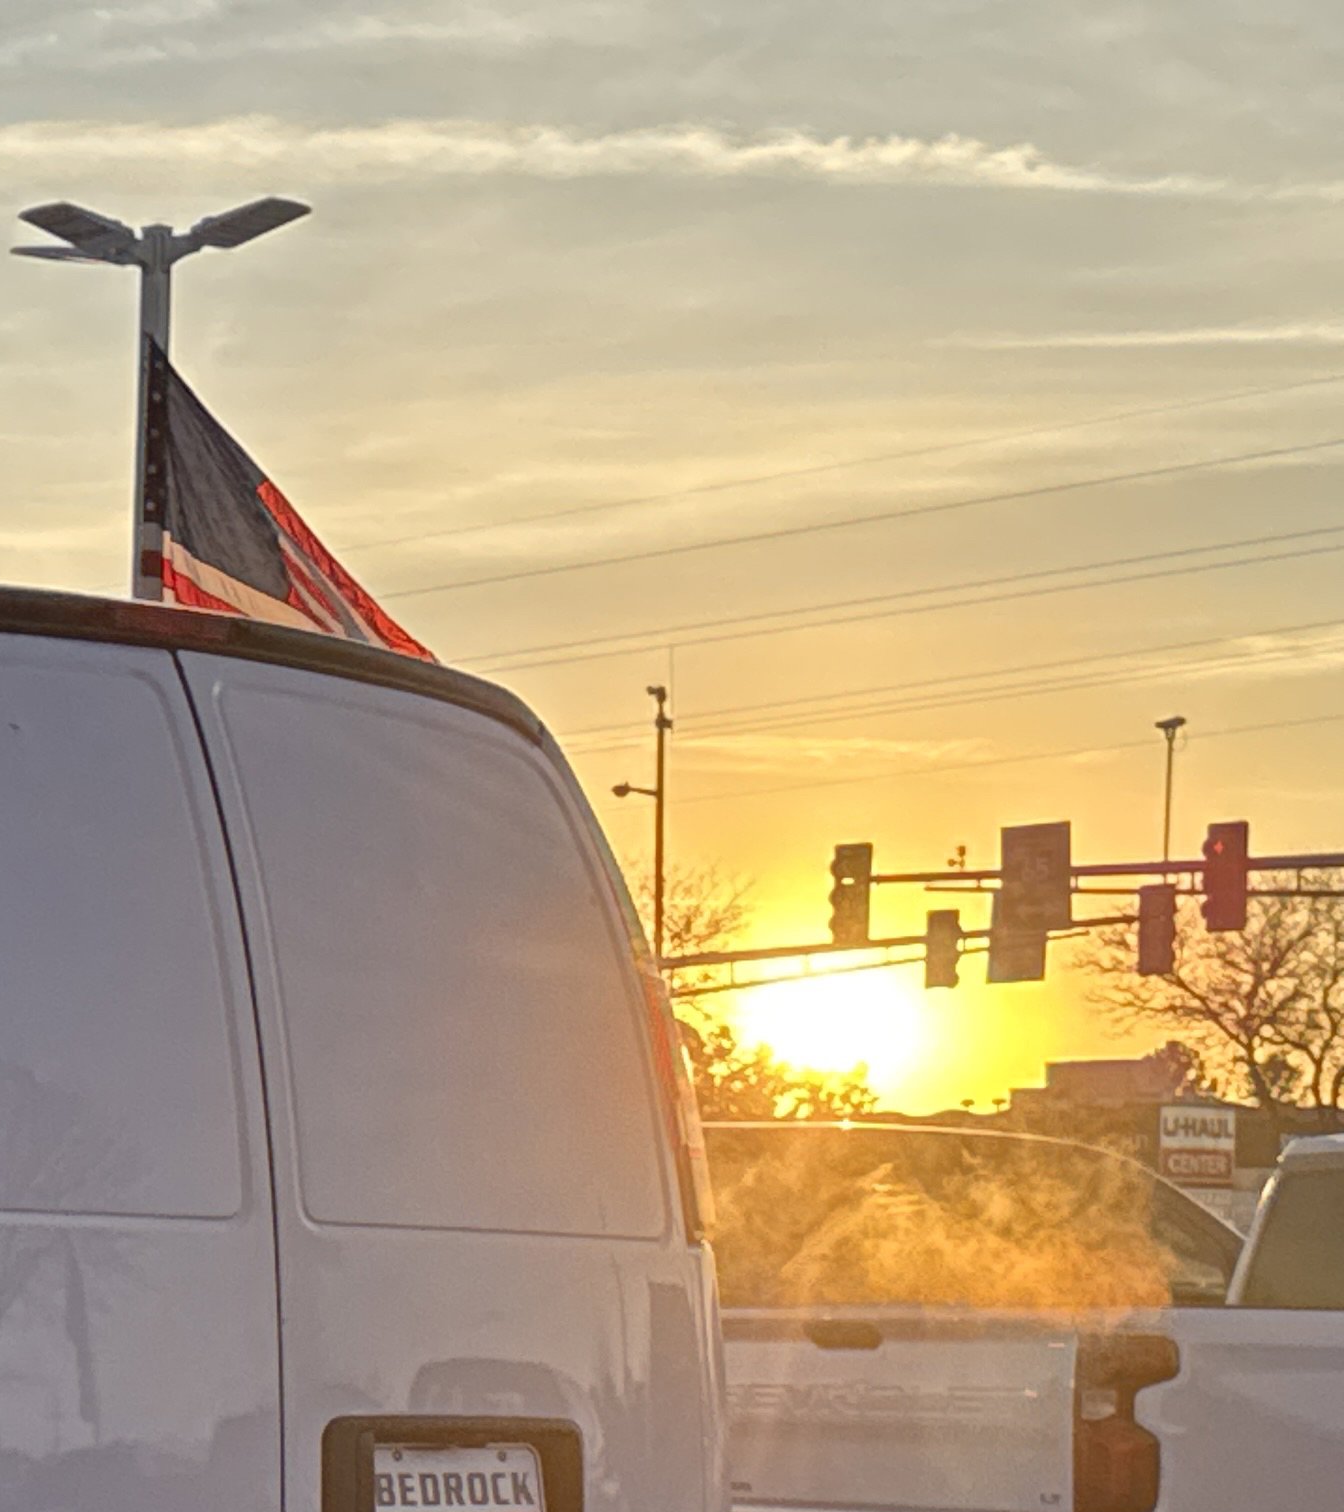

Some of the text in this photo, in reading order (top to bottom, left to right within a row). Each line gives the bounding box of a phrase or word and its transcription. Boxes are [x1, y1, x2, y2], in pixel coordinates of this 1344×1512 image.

[1163, 1116, 1234, 1139] U-HAUL
[1169, 1154, 1228, 1174] CENTER
[374, 1471, 535, 1506] BEDROCK
